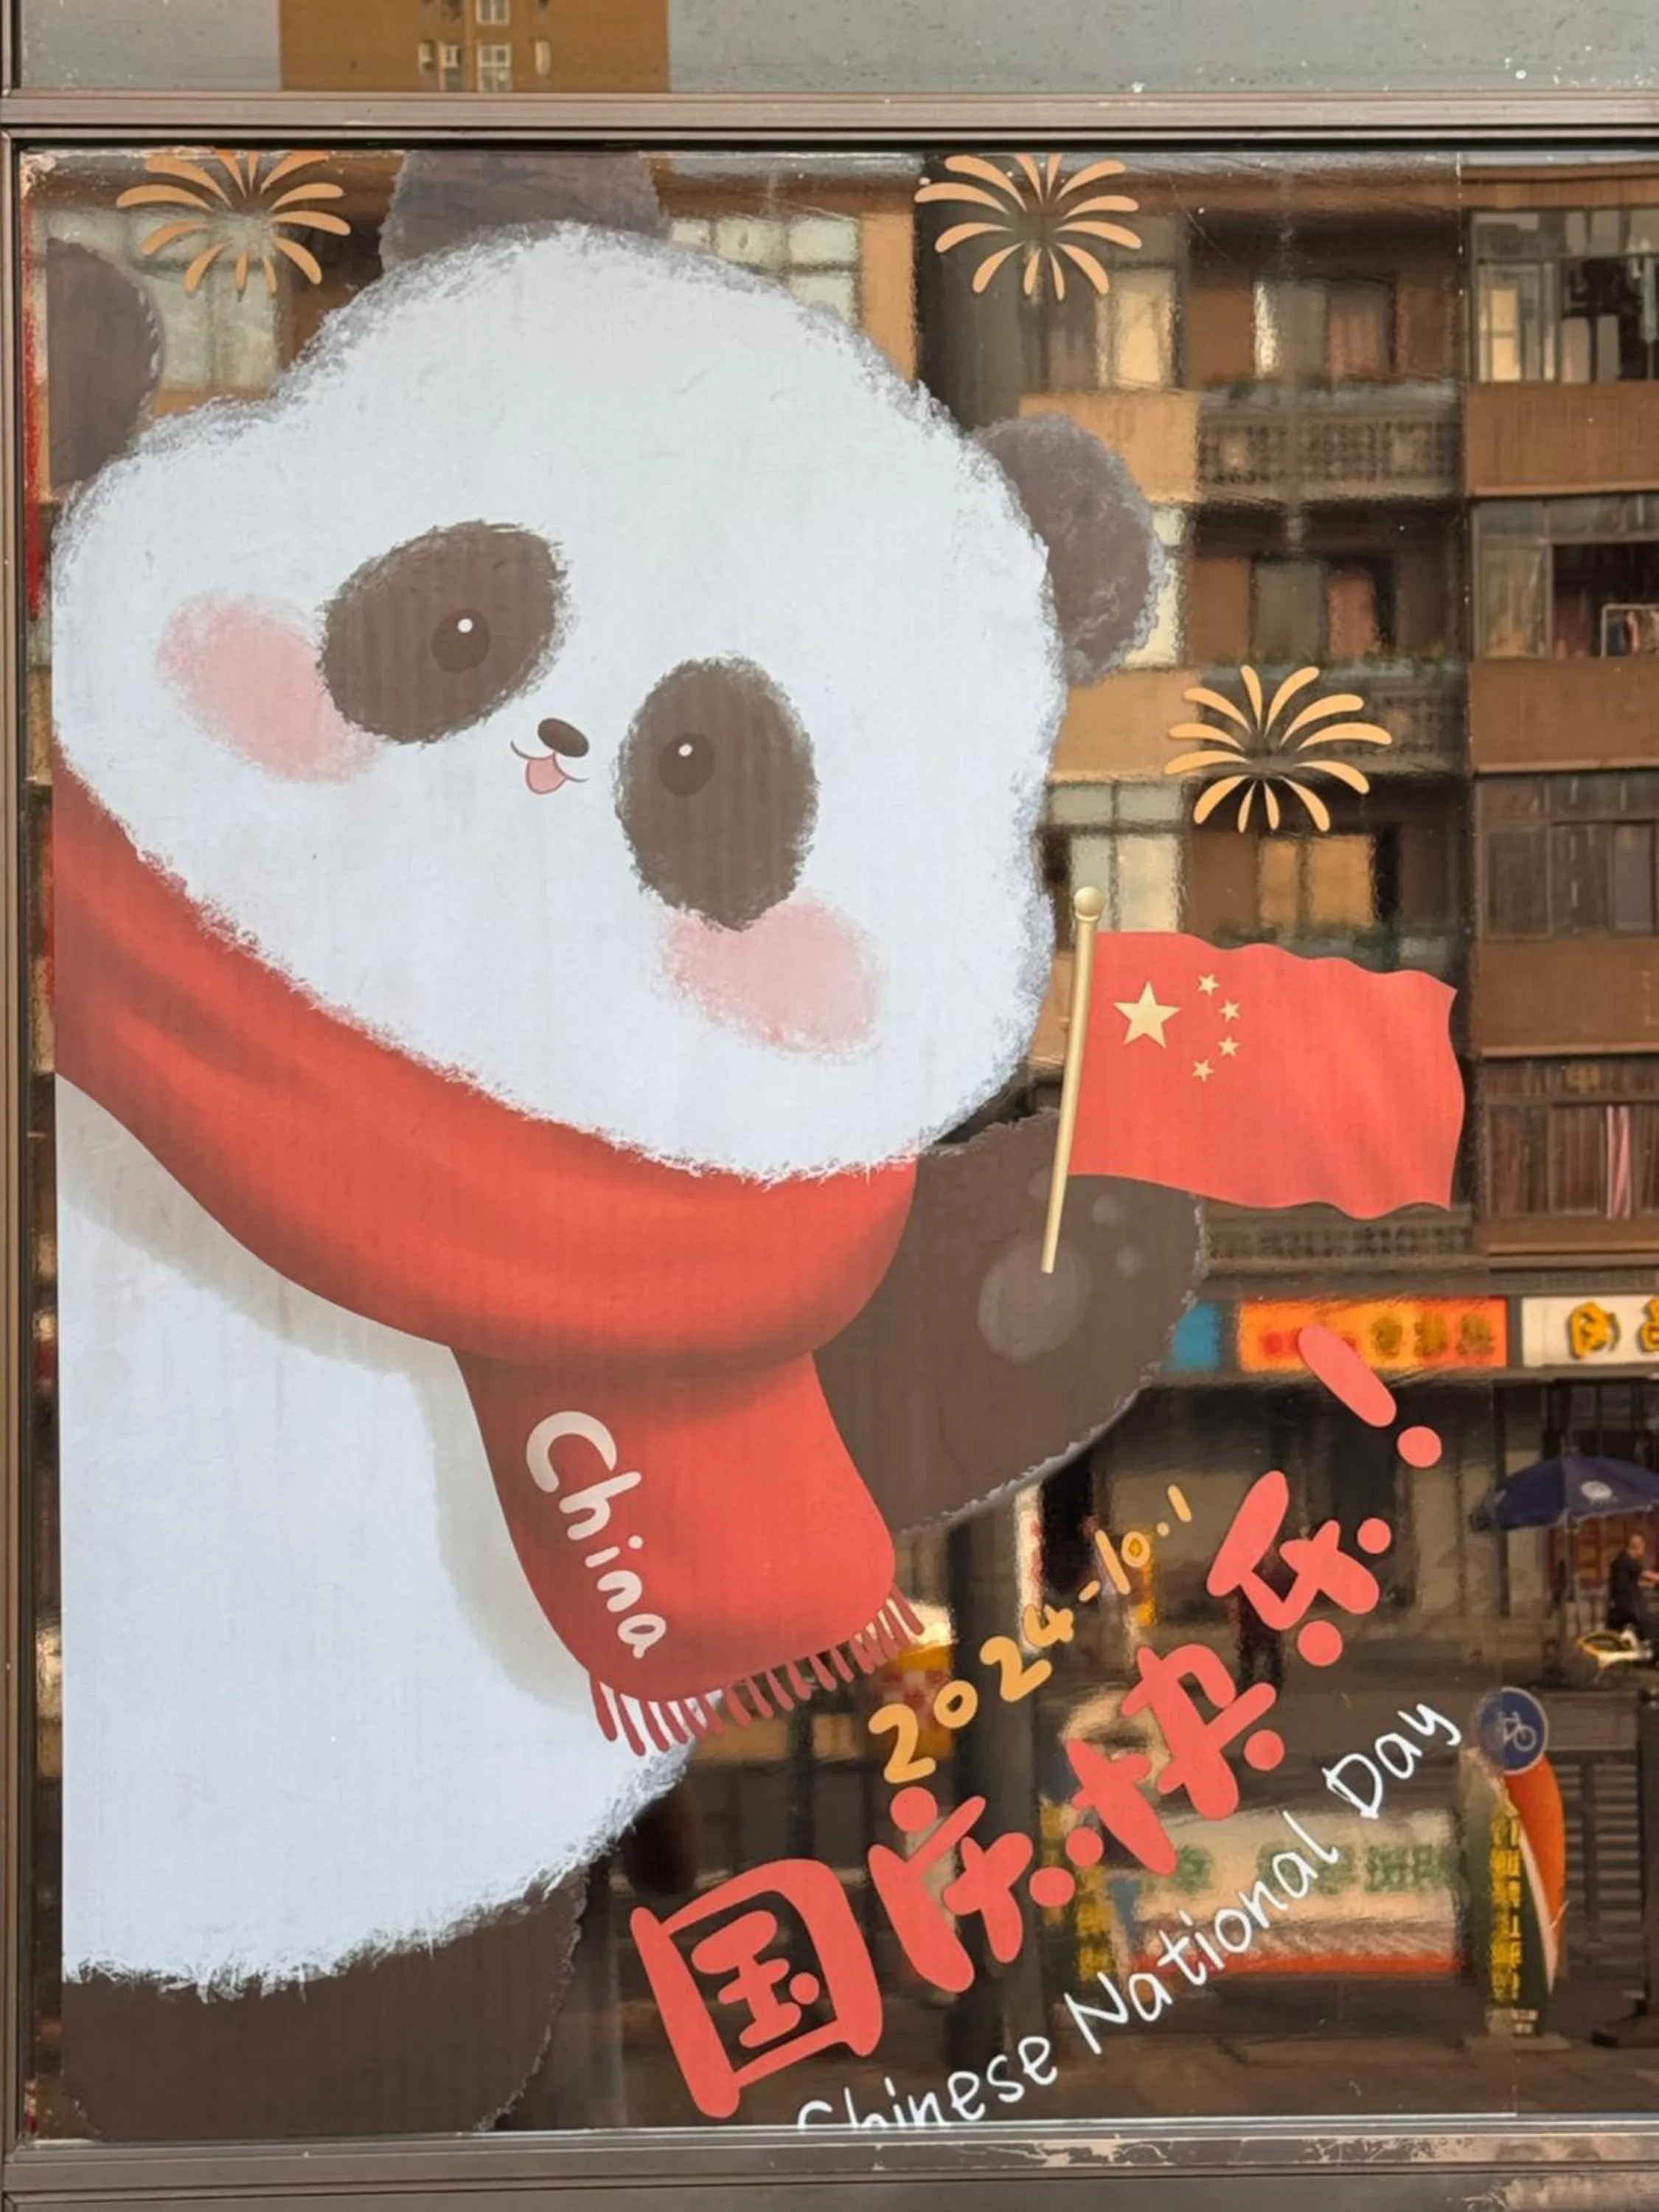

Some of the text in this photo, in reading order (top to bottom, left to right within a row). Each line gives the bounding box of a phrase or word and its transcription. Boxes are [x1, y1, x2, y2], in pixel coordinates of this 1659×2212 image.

[526, 1411, 667, 1659] China
[1064, 1811, 1340, 2055] National
[1322, 1703, 1463, 1820] Day
